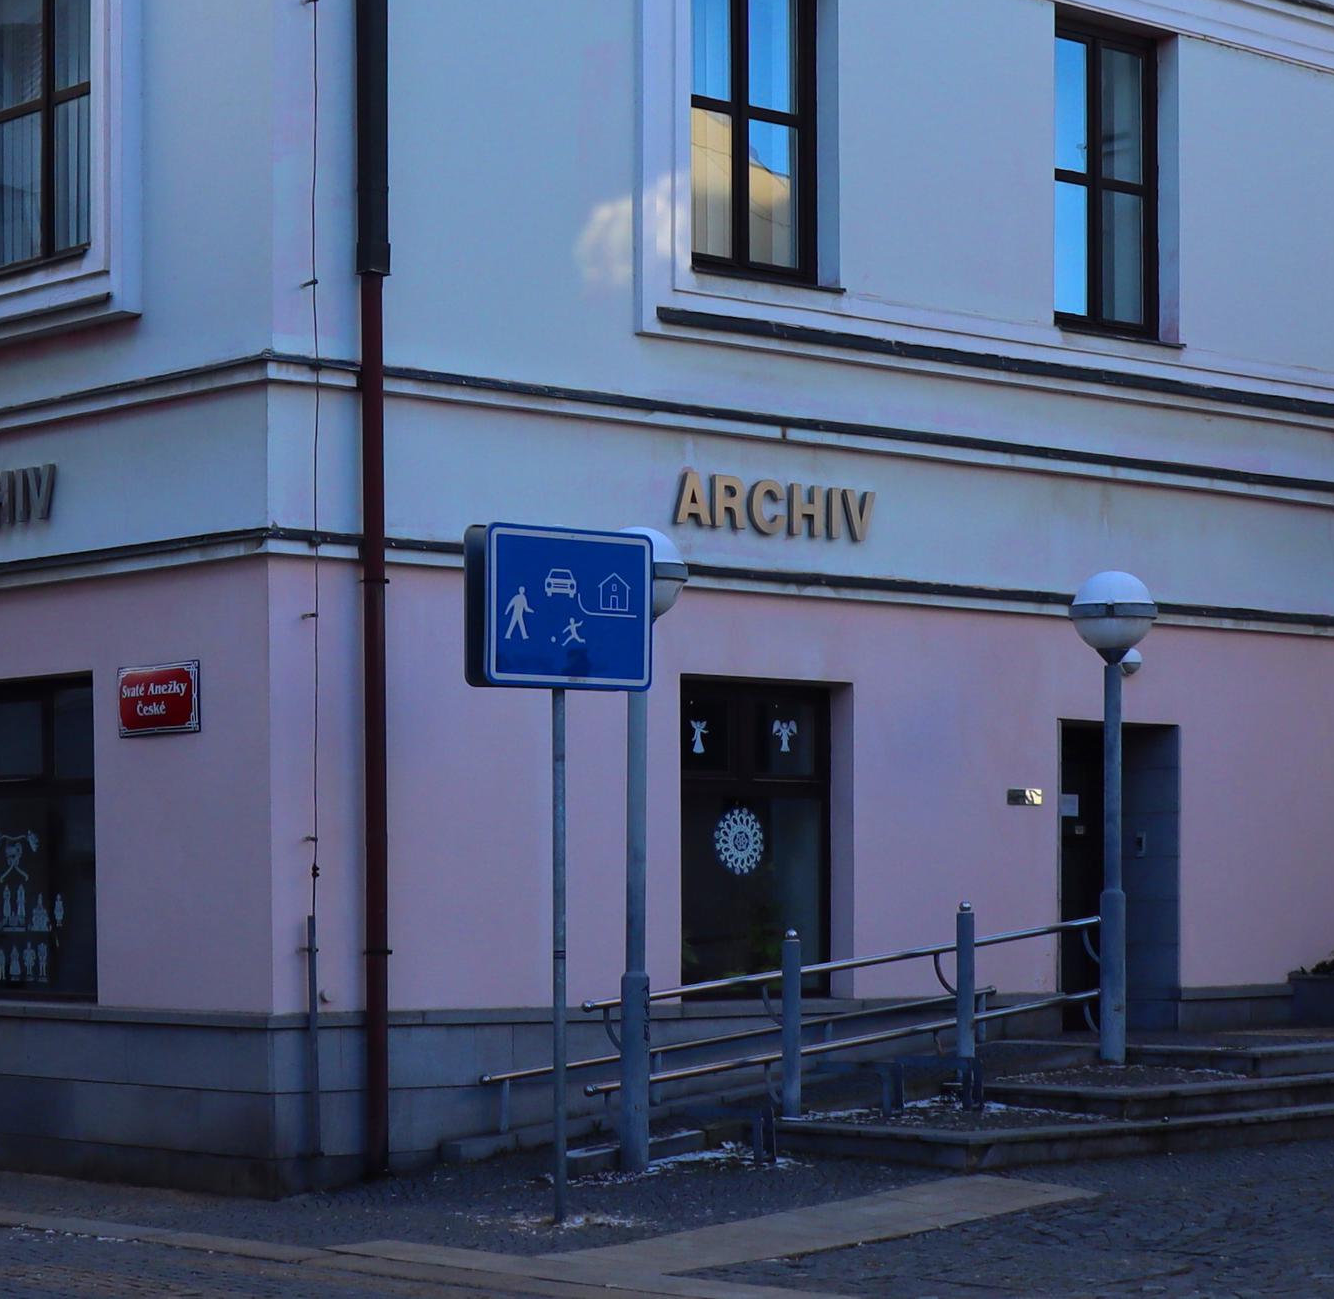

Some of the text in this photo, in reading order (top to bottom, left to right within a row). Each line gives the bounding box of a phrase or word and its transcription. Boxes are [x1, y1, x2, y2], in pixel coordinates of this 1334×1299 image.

[674, 471, 877, 542] ARCHIV
[121, 680, 188, 699] Svaté Anežky
[136, 700, 167, 716] České
